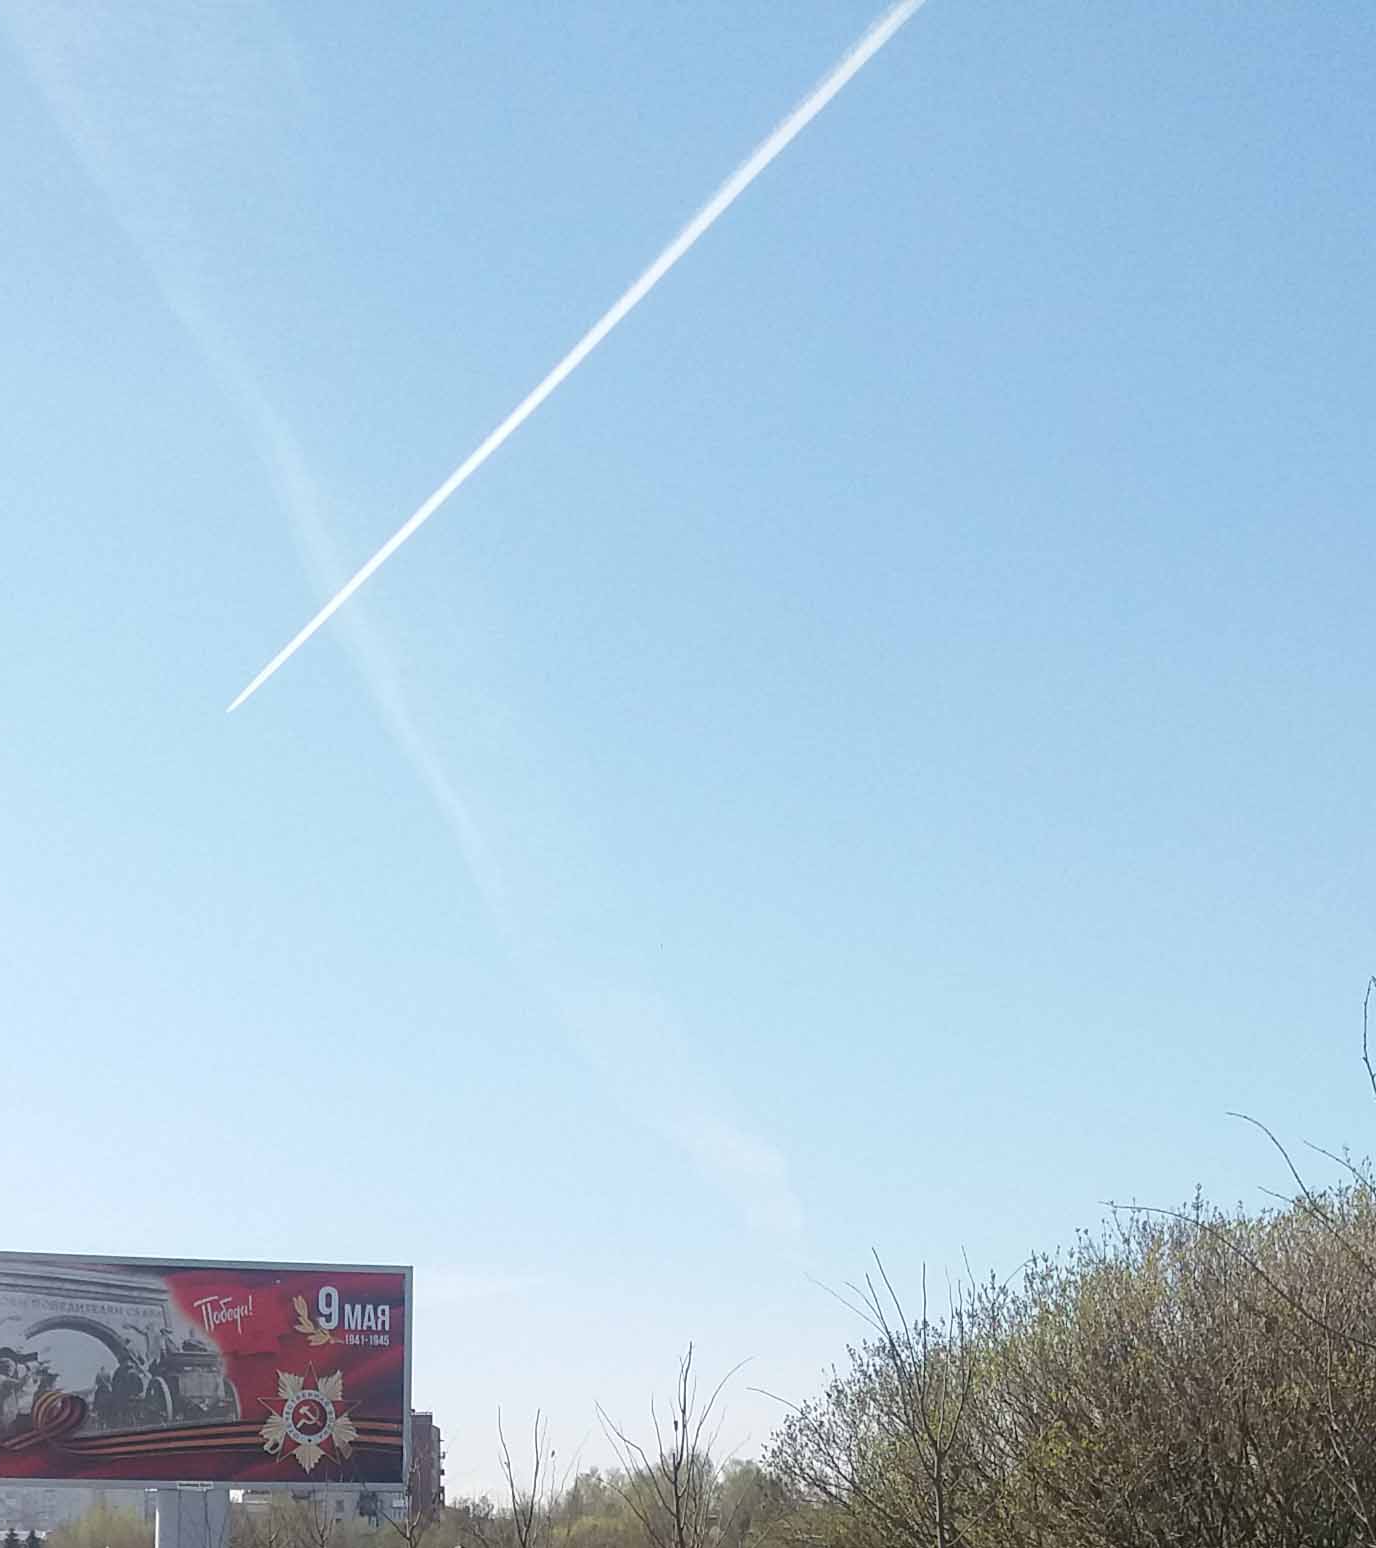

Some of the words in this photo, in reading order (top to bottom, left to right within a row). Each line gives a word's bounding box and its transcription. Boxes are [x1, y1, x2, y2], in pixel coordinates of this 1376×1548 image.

[318, 1286, 339, 1330] 9
[344, 1304, 390, 1331] МАЯ
[345, 1334, 390, 1346] 1941-1945
